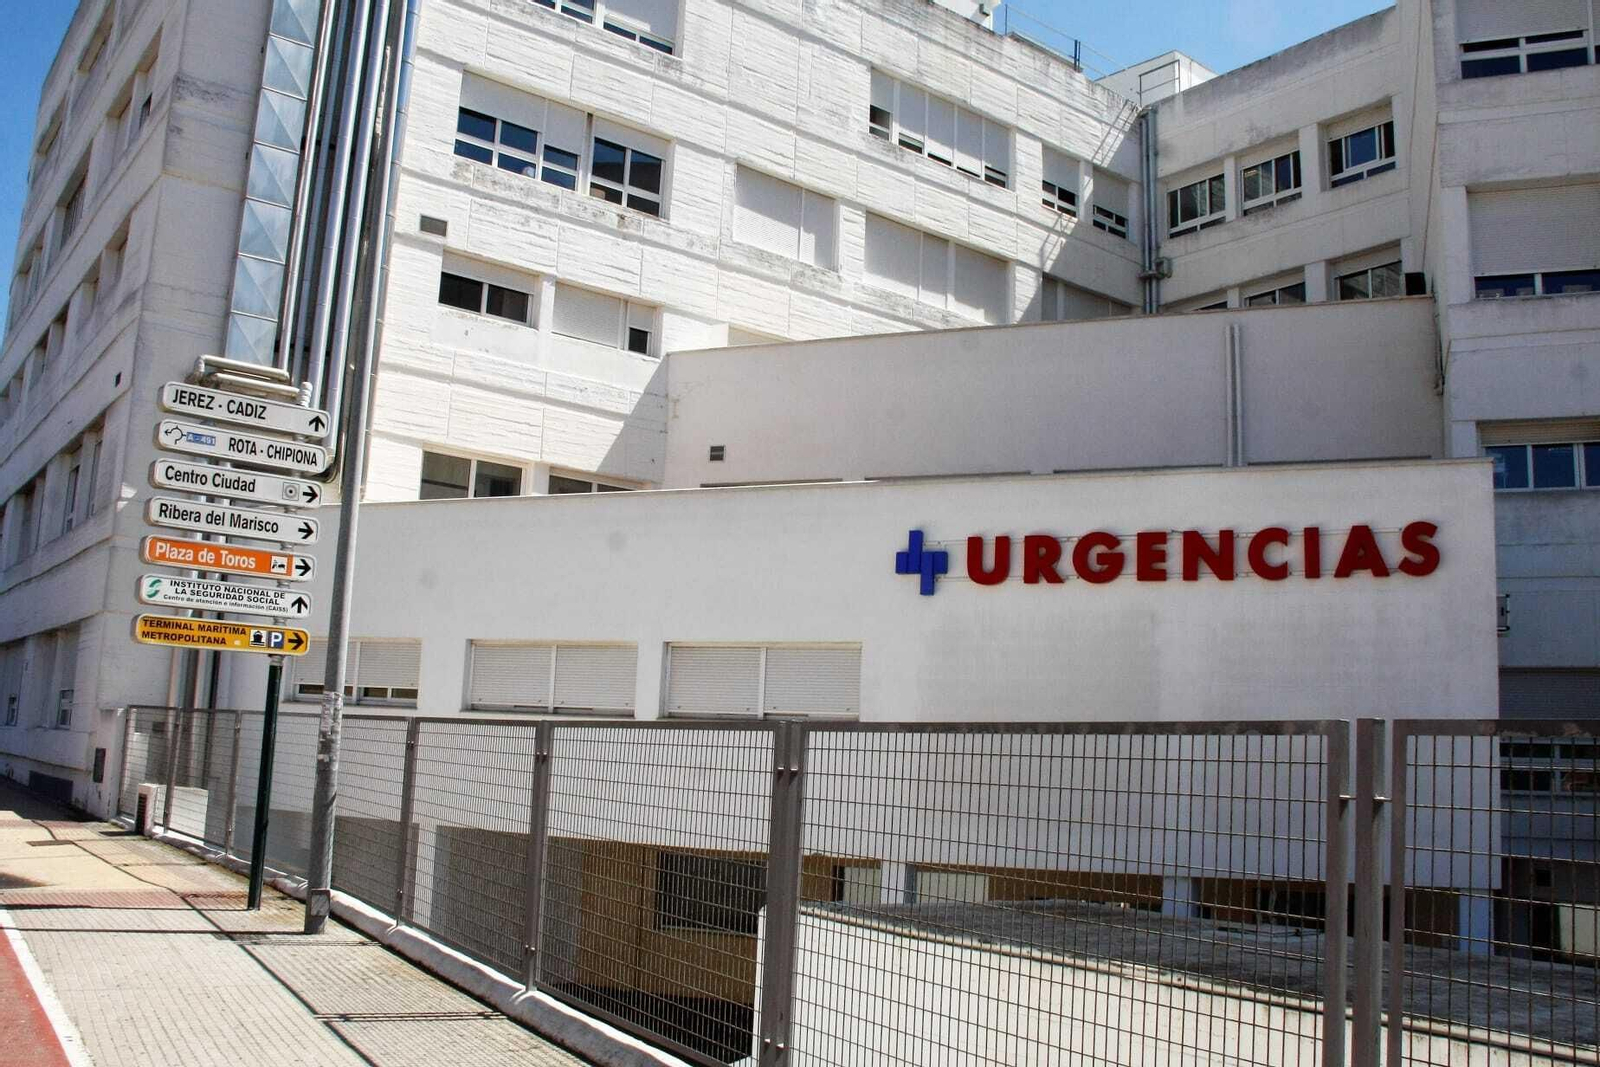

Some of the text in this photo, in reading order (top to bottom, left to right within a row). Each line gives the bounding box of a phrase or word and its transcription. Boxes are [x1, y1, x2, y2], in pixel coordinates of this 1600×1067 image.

[172, 389, 215, 411] JEREZ
[227, 399, 267, 420] CADIZ
[228, 437, 257, 456] ROTA
[267, 444, 317, 467] CHIPIONA
[165, 465, 256, 493] Centro Ciudad
[159, 503, 279, 533] Ribera del Marisco
[155, 542, 256, 569] Plaza de Toros
[966, 521, 1441, 586] URGENCIAS
[163, 594, 184, 602] Centro
[170, 580, 221, 592] INSTITUTO
[224, 586, 271, 598] NACIONAL
[175, 587, 280, 606] LA SEGURIDAD SOCIAL
[143, 619, 194, 631] TERMINAL
[141, 630, 227, 645] METROPOLITANA
[270, 632, 282, 647] P
